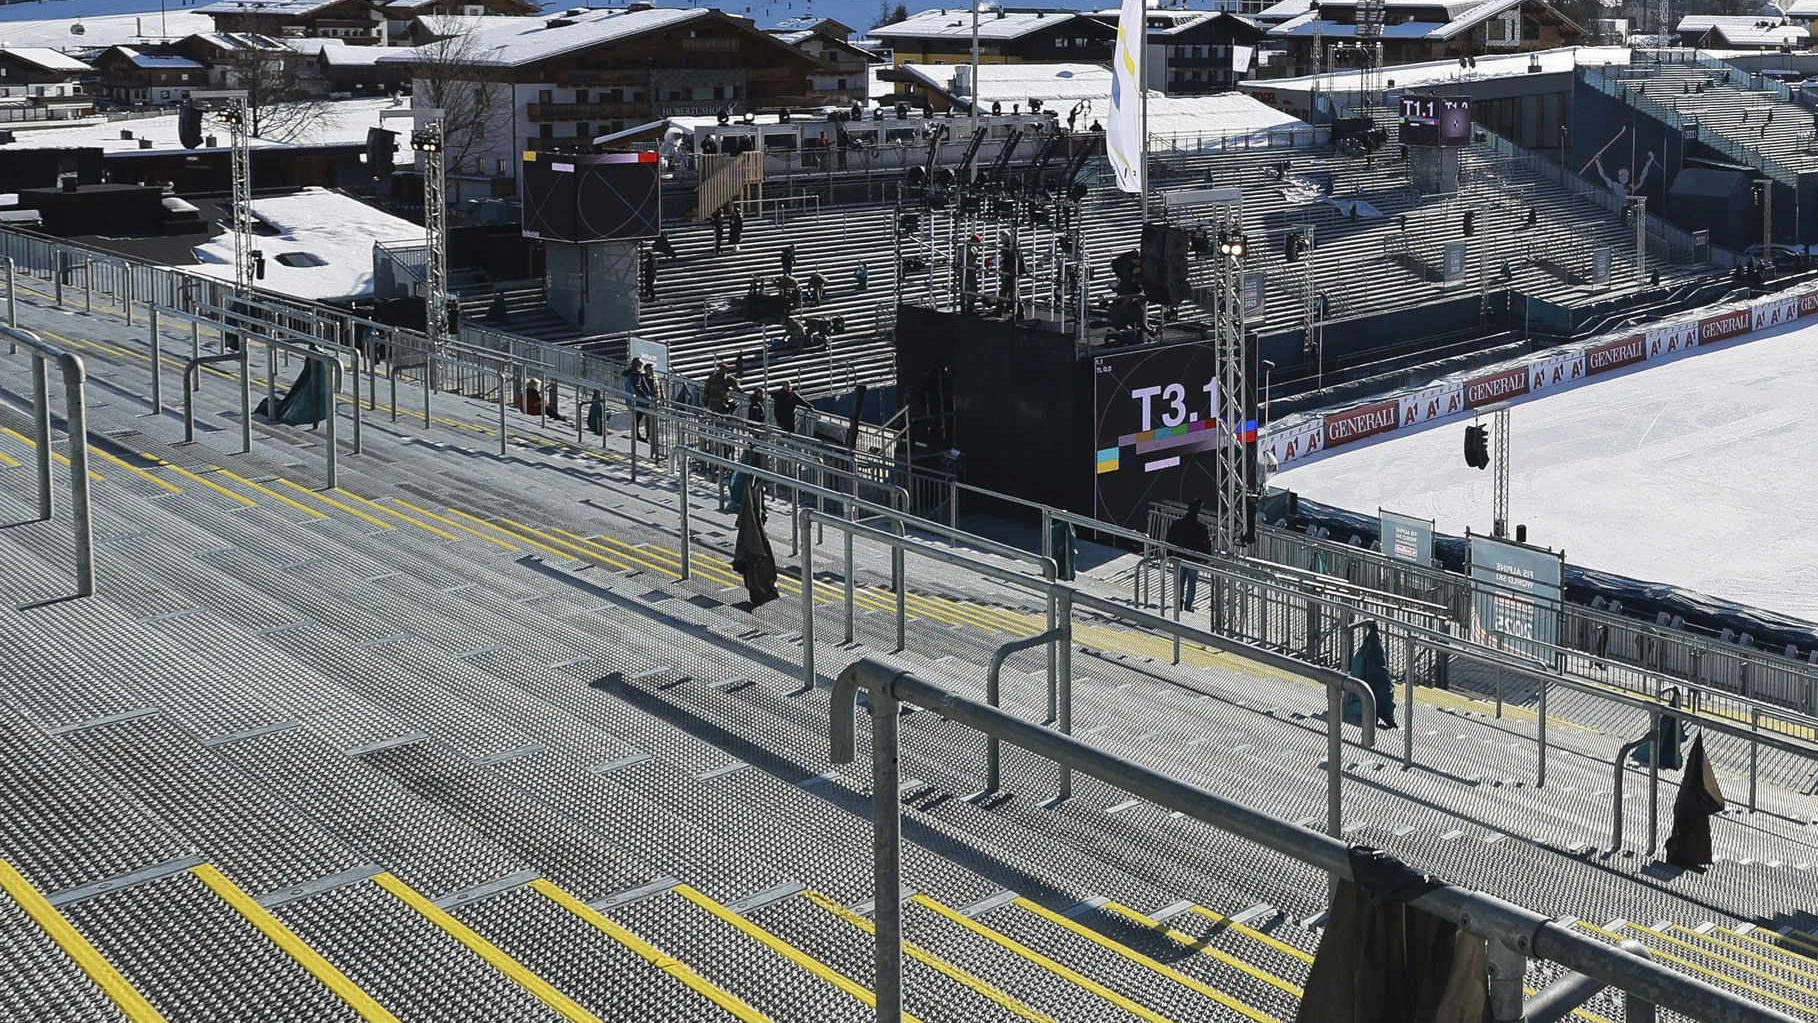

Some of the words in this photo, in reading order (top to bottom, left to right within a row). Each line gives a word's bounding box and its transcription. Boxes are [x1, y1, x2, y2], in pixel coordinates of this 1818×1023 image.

[1403, 100, 1434, 118] T1.1
[1702, 314, 1750, 339] GENERALI
[1756, 311, 1766, 329] A1
[1771, 307, 1781, 325] A1
[1786, 303, 1796, 321] A1
[1590, 341, 1643, 369] GENERALI
[1651, 335, 1661, 357] A1
[1667, 332, 1679, 352] A1
[1685, 329, 1696, 348] A1
[1469, 372, 1526, 402] GENERALI
[1533, 368, 1545, 389] A1
[1552, 363, 1564, 384] A1
[1571, 358, 1583, 378] A1
[1131, 376, 1220, 432] T3.1
[1404, 405, 1418, 427] A1
[1426, 396, 1440, 420] A1
[1447, 390, 1461, 413] A1
[1329, 408, 1396, 441] GENERALI
[1284, 437, 1298, 462] A1
[1306, 429, 1321, 453] A1
